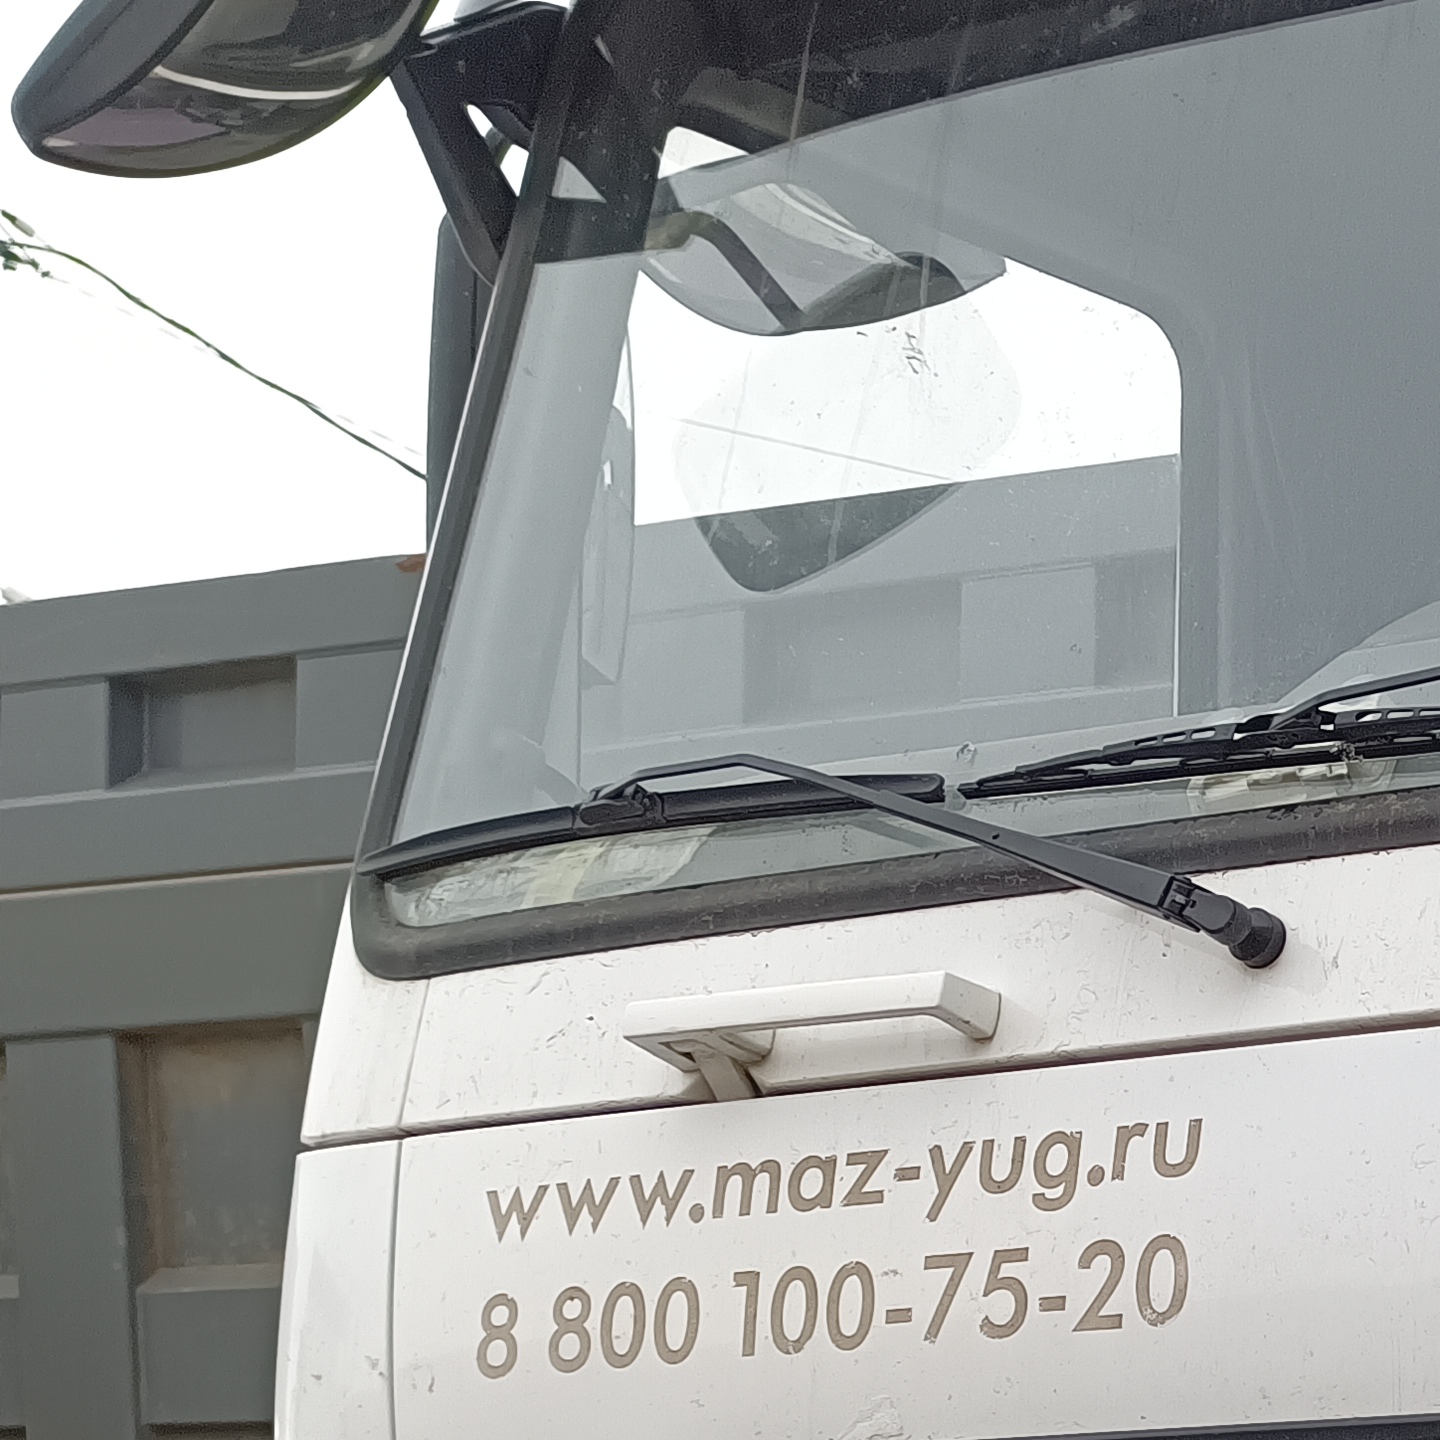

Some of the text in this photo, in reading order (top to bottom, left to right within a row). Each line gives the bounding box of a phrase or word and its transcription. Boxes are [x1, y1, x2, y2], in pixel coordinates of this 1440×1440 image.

[486, 1118, 1202, 1243] www.maz-yug.ru
[475, 1234, 1189, 1380] 8 800 100-75-20
